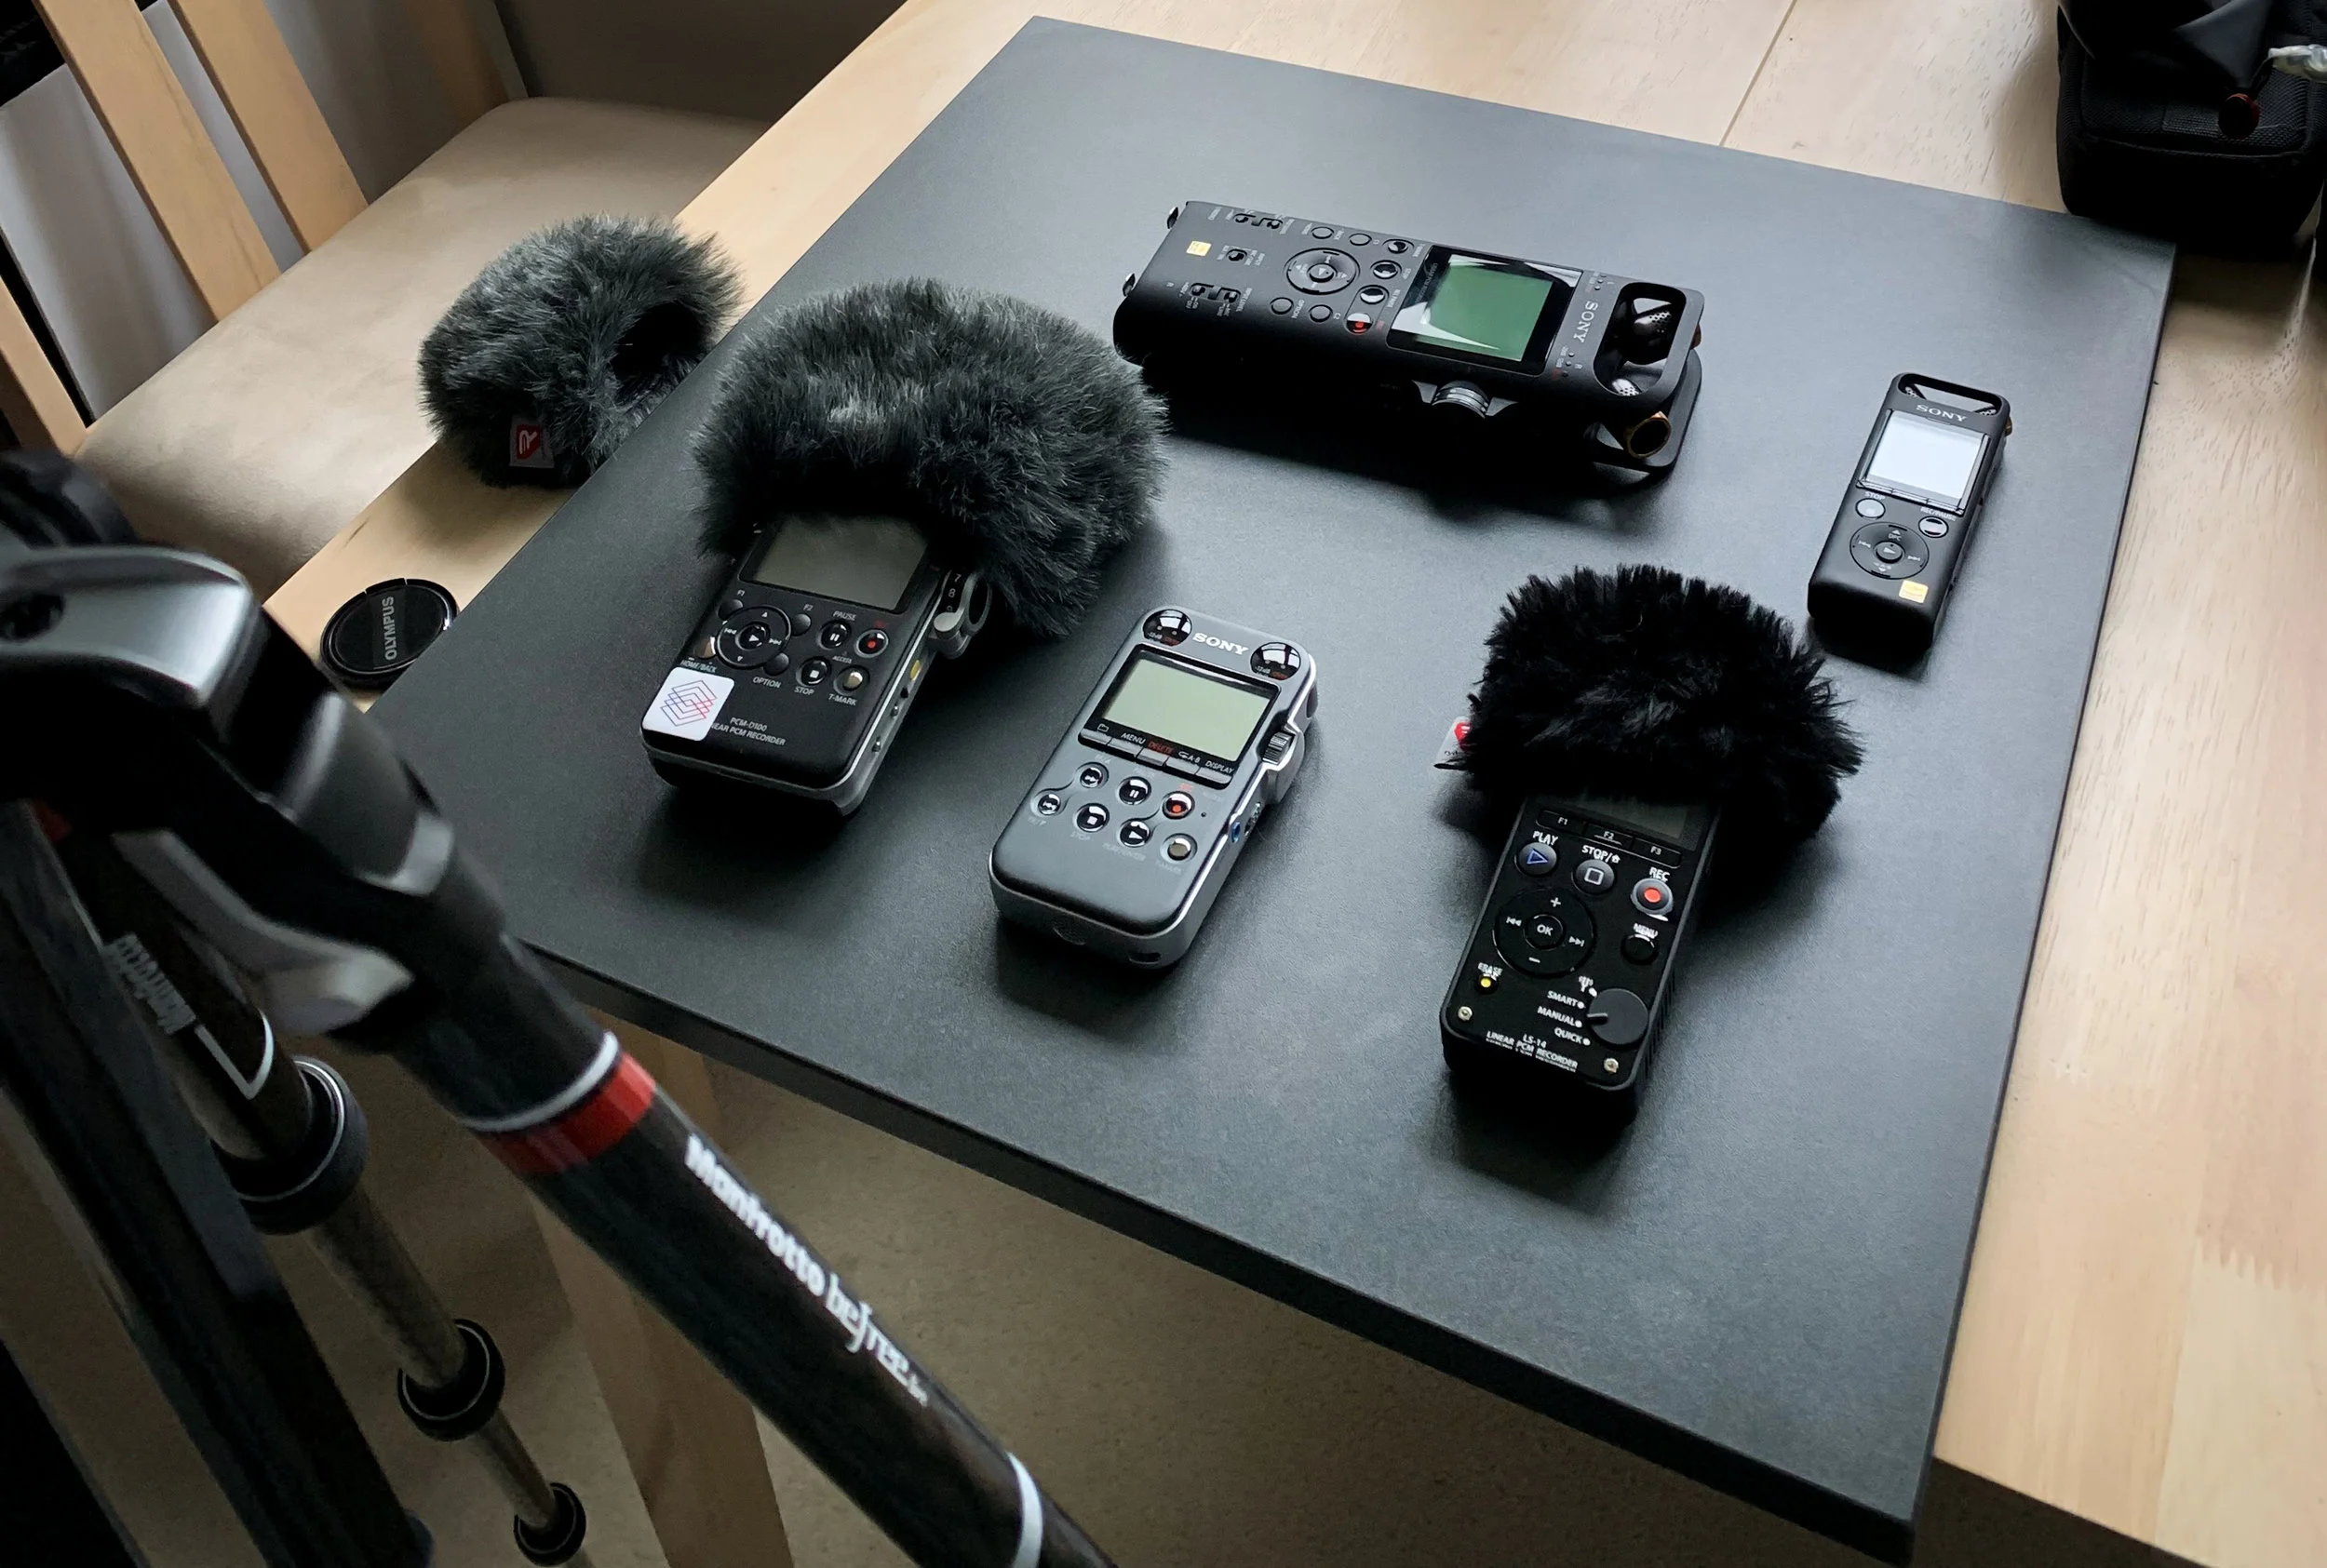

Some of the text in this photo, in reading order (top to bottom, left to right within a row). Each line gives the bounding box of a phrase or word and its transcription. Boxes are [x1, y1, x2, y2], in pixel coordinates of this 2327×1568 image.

[1573, 301, 1599, 343] SONY
[1916, 403, 1968, 423] SONY
[1864, 490, 1886, 501] STOP
[954, 572, 962, 583] 7
[948, 588, 956, 598] 8
[802, 603, 814, 611] F2
[832, 610, 857, 622] PAUSE
[382, 596, 397, 661] OLYMPUS
[1192, 632, 1249, 655] SONY
[752, 676, 782, 689] OPTION
[794, 686, 815, 696] STOP
[827, 693, 858, 706] T-MARK
[729, 717, 768, 732] PCM-D100
[729, 726, 747, 737] PCM
[747, 730, 787, 746] RECORDER
[1120, 732, 1146, 745] MENU
[1204, 759, 1235, 774] DISPLAY
[1557, 816, 1568, 825] F1
[1532, 830, 1559, 846] PLAY
[1603, 830, 1615, 840] F2
[1650, 846, 1661, 855] F3
[1648, 866, 1671, 882] REC
[1537, 924, 1554, 936] OK
[1633, 922, 1659, 939] MENU
[1477, 961, 1504, 975] ERASE
[1546, 990, 1578, 1007] SMART
[1537, 1005, 1576, 1027] MANUAL
[1522, 1033, 1547, 1049] LS-14
[1554, 1026, 1583, 1044] QUICK
[1486, 1030, 1515, 1046] LINEAR
[1515, 1039, 1535, 1052] PCM
[1536, 1047, 1579, 1069] RECORDER
[684, 1132, 826, 1297] Manfrotto
